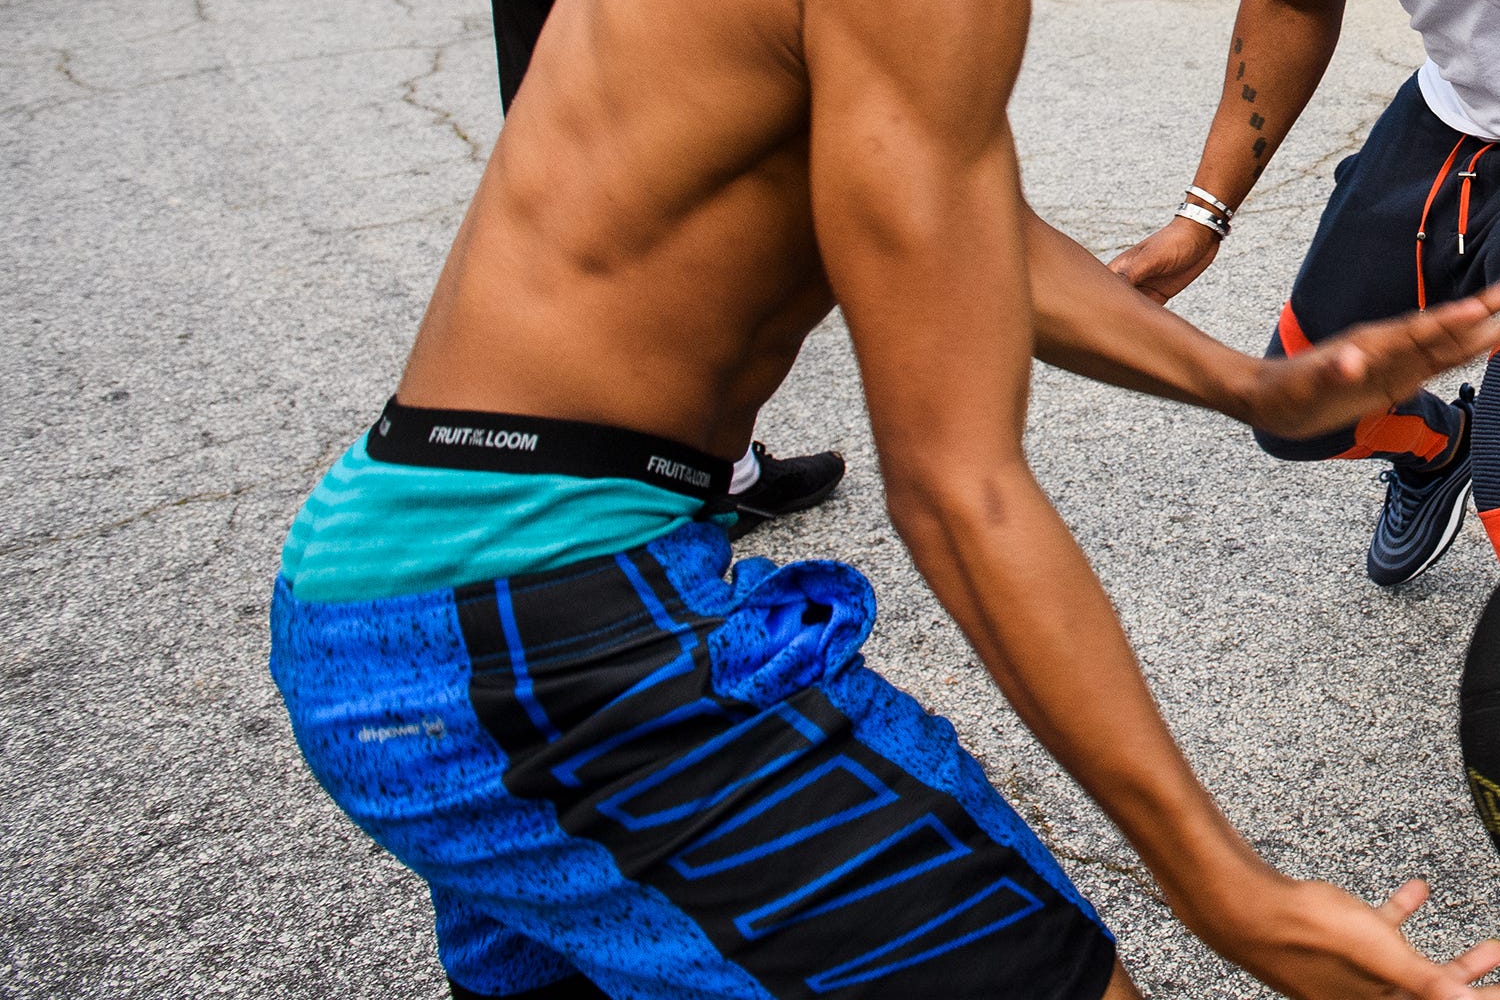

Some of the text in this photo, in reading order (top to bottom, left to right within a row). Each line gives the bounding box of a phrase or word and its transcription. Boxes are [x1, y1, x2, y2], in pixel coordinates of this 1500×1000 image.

[428, 425, 473, 445] FRUIT
[485, 430, 538, 451] LOOM
[646, 455, 687, 481] FRUIT
